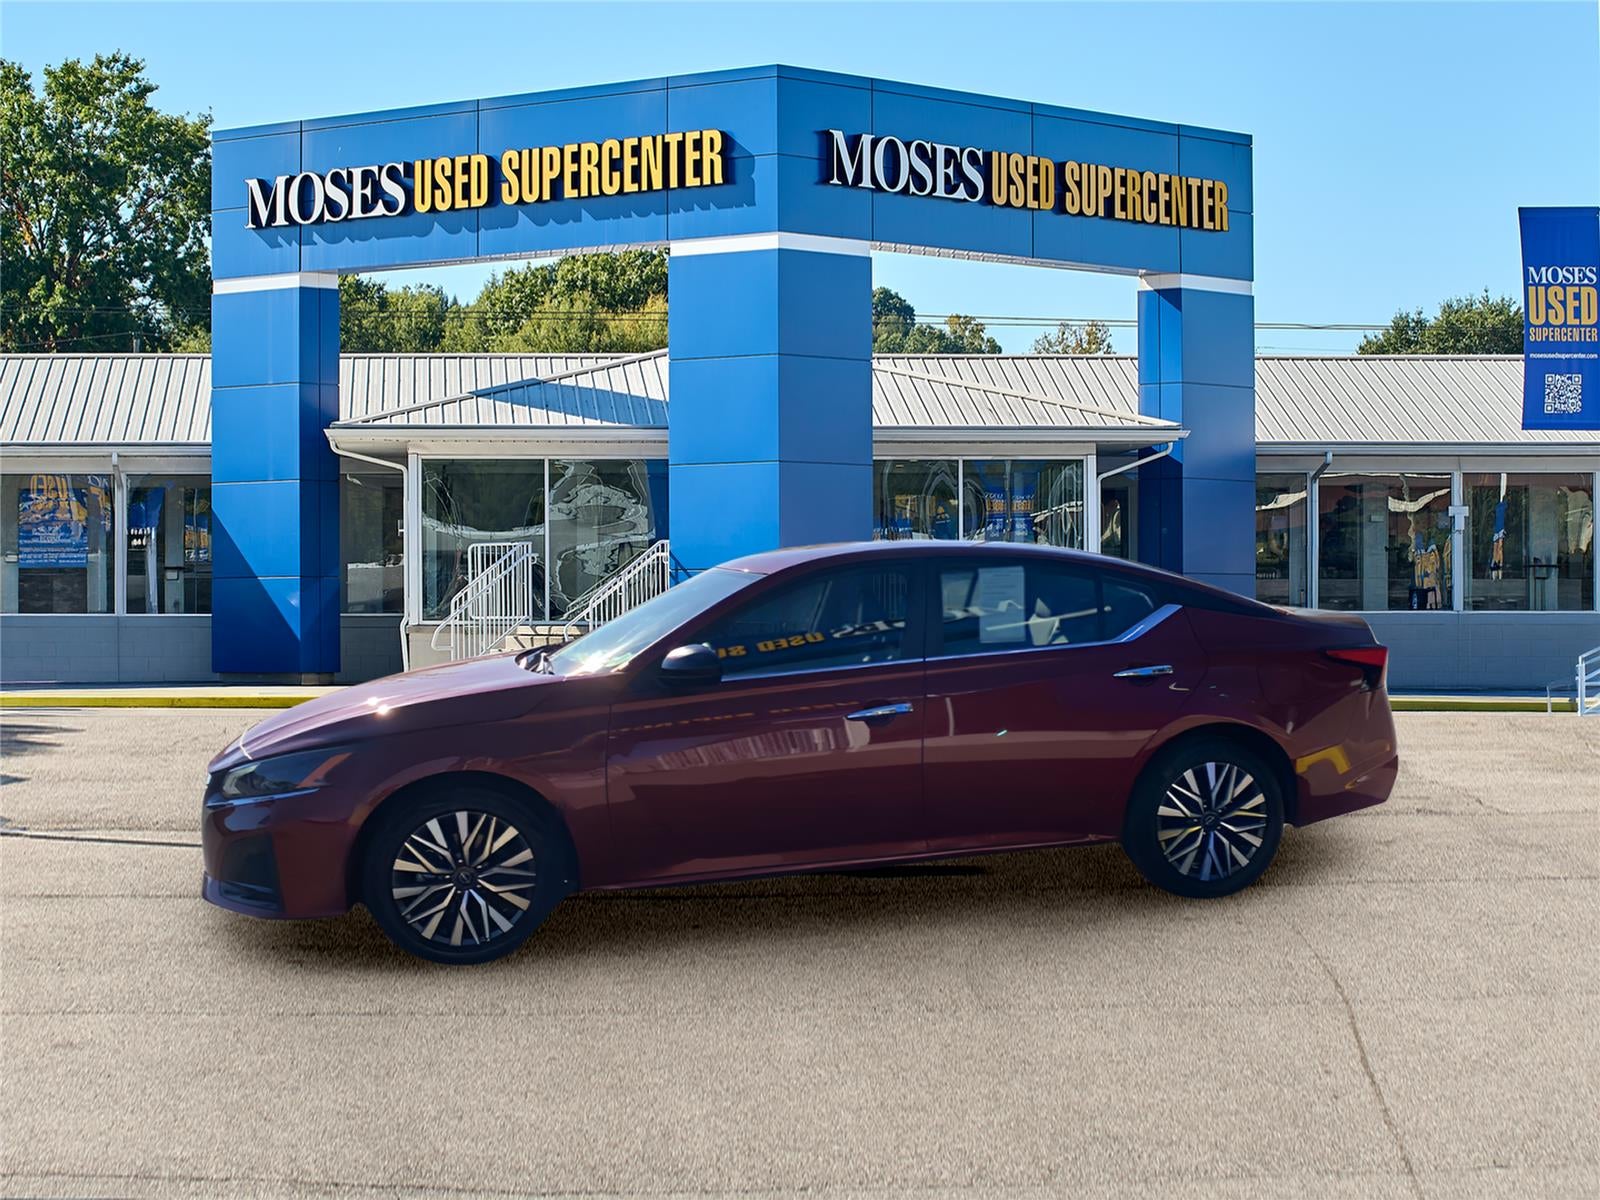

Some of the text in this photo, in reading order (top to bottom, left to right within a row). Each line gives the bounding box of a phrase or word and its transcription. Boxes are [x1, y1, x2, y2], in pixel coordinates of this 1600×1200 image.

[244, 129, 724, 230] MOSES USED SUPERCENTER
[829, 129, 1230, 232] MOSES USED SUPERCENTER
[1528, 266, 1597, 285] MOSES
[1528, 286, 1598, 326] USED
[1529, 327, 1598, 342] SUPERCENTER
